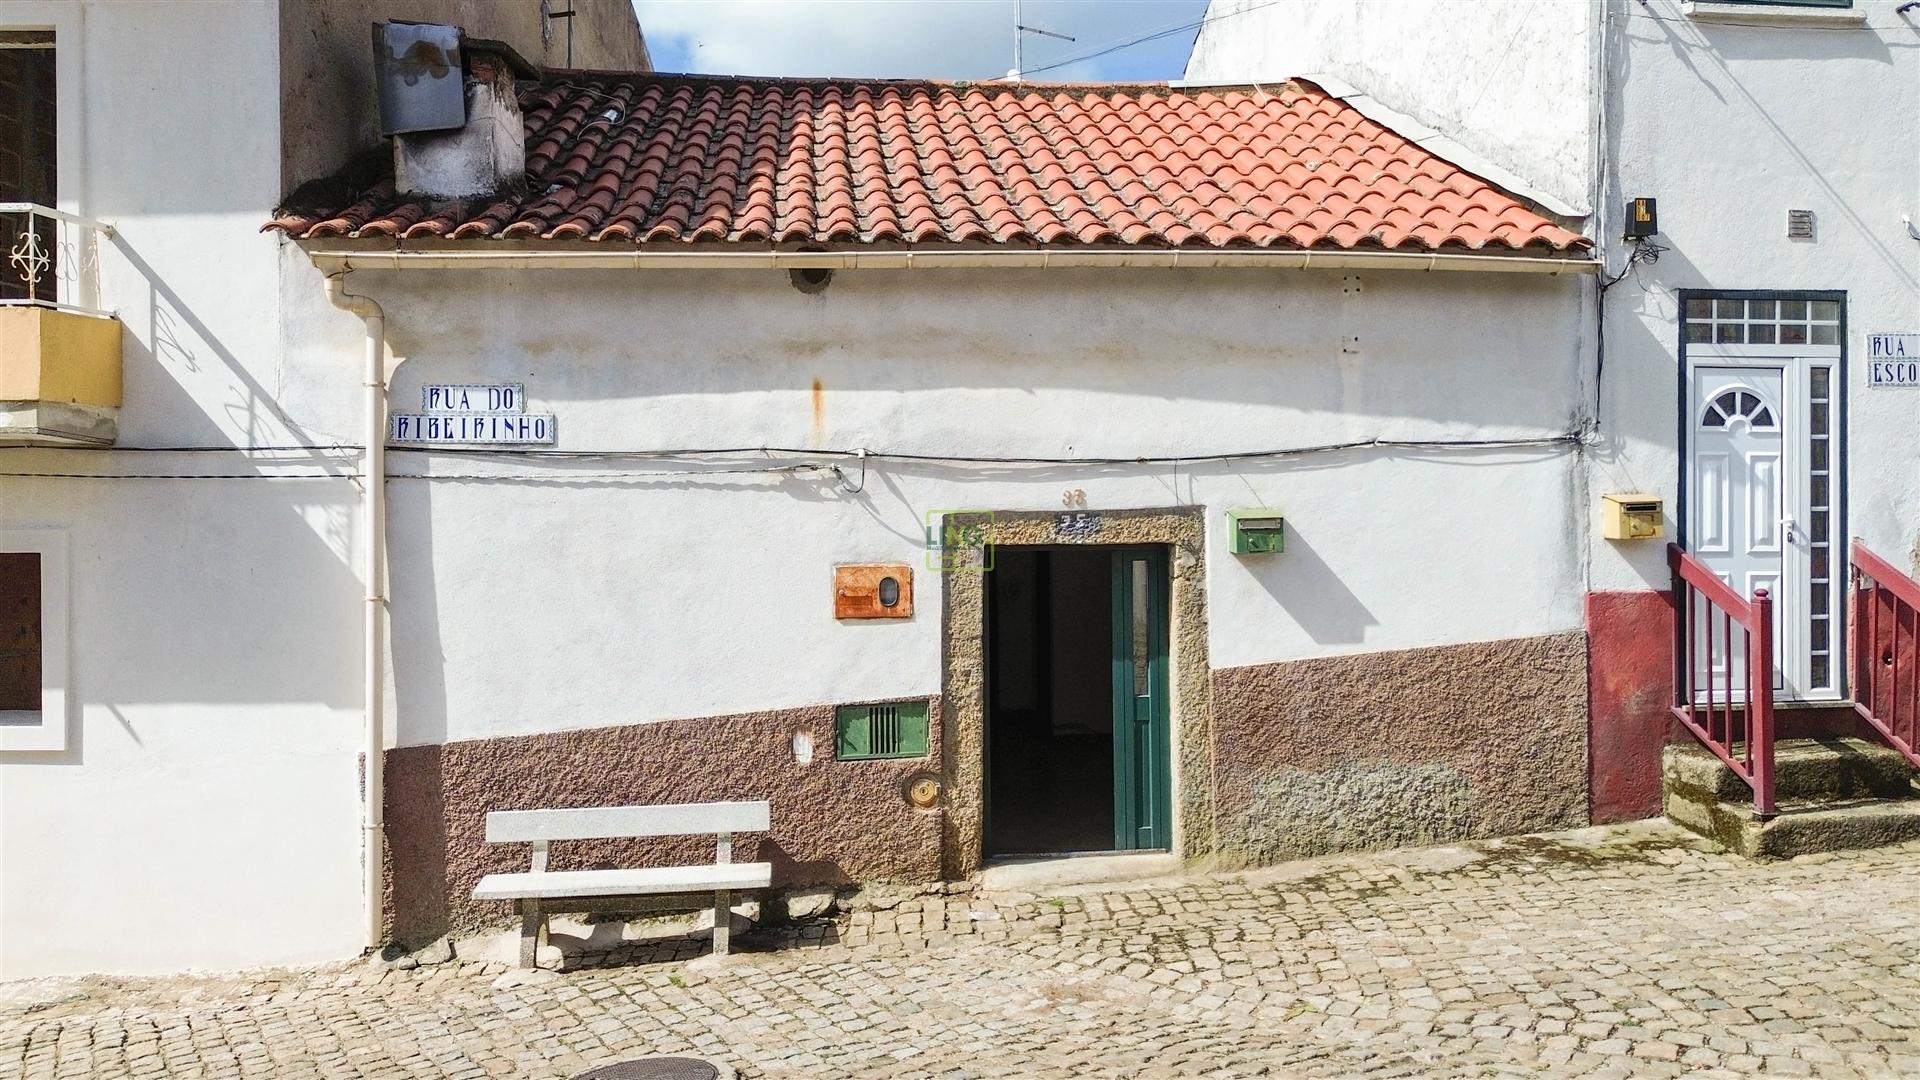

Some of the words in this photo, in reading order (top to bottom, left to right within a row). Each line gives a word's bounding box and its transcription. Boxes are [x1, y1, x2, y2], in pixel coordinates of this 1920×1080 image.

[1873, 336, 1905, 356] RUA
[429, 387, 470, 410] RUA
[488, 388, 514, 411] DO
[397, 417, 545, 440] RIBEIRINHO
